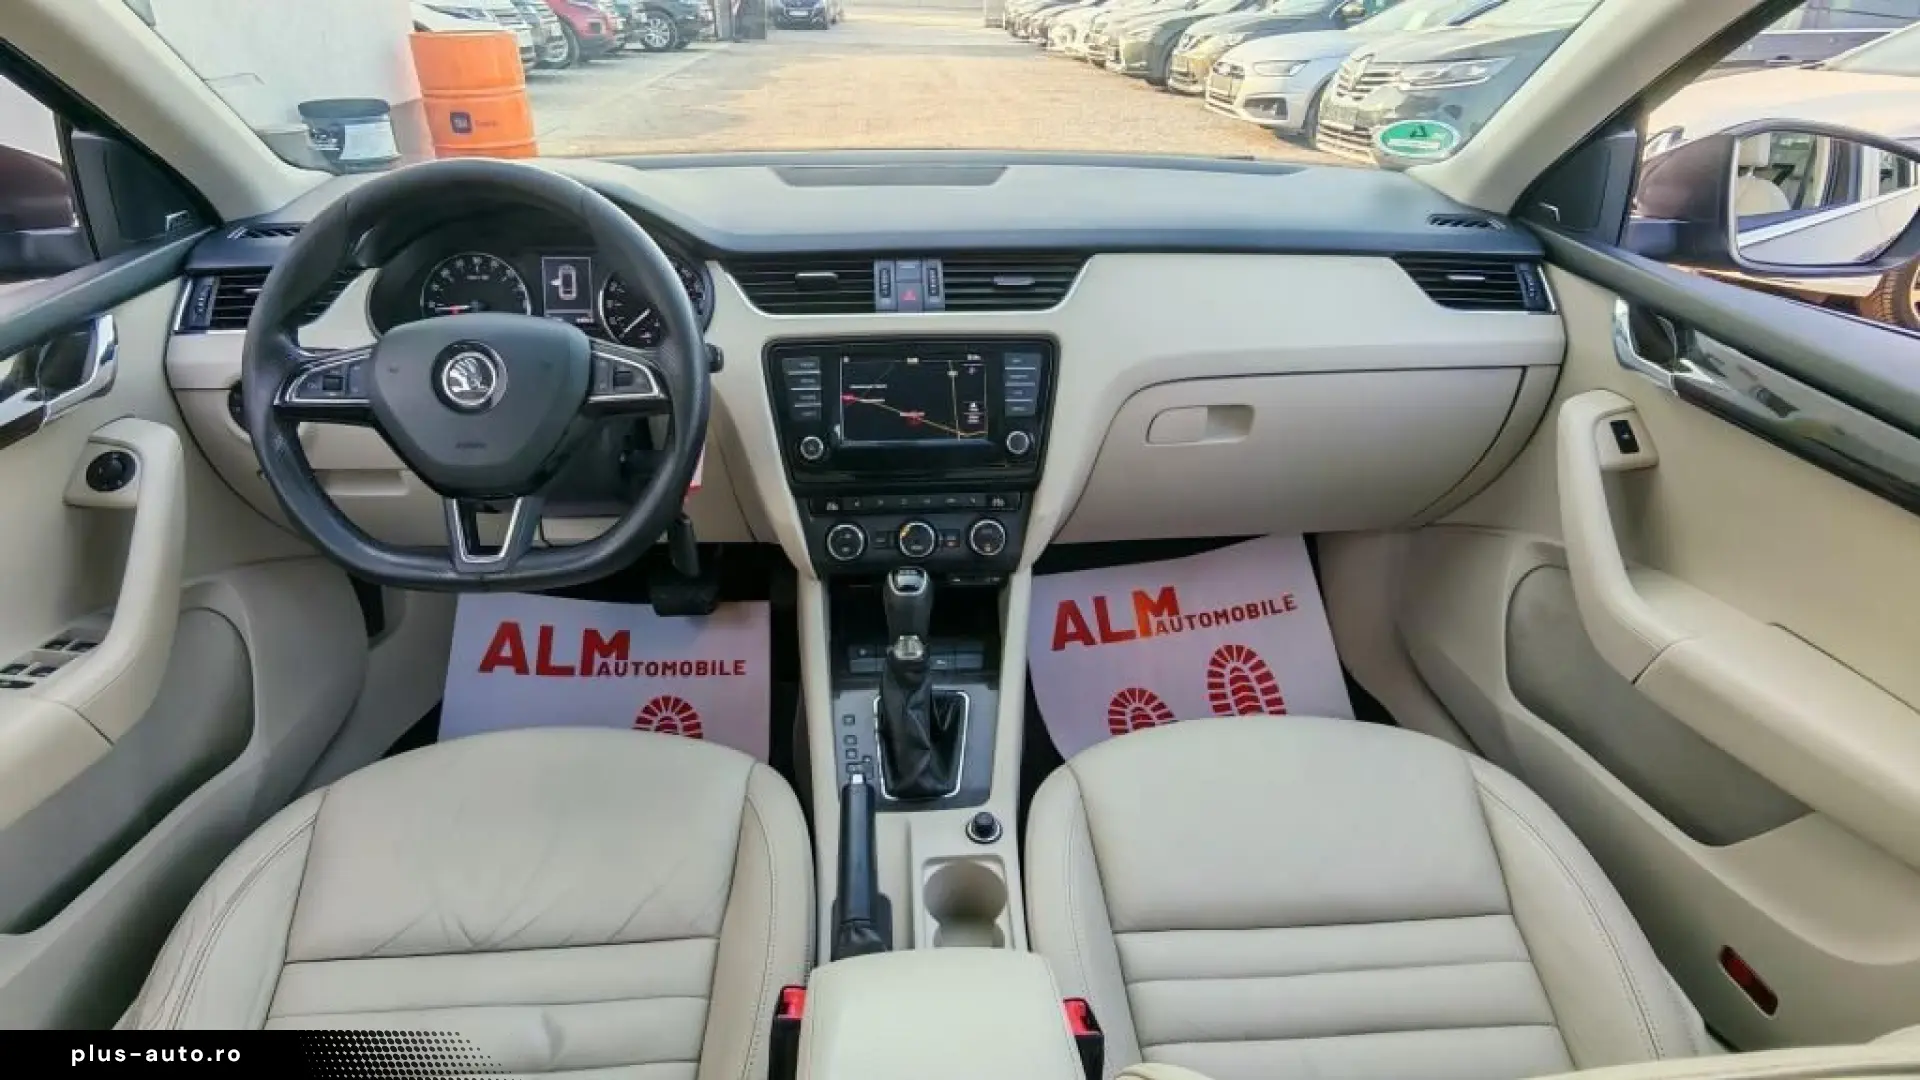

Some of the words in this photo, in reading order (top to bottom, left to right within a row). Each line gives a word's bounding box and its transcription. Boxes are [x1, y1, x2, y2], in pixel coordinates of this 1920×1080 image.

[1051, 586, 1179, 650] ALM
[1155, 593, 1298, 636] AUTOMOBILE
[478, 621, 630, 677] ALM
[598, 660, 747, 676] AUTOMOBILE
